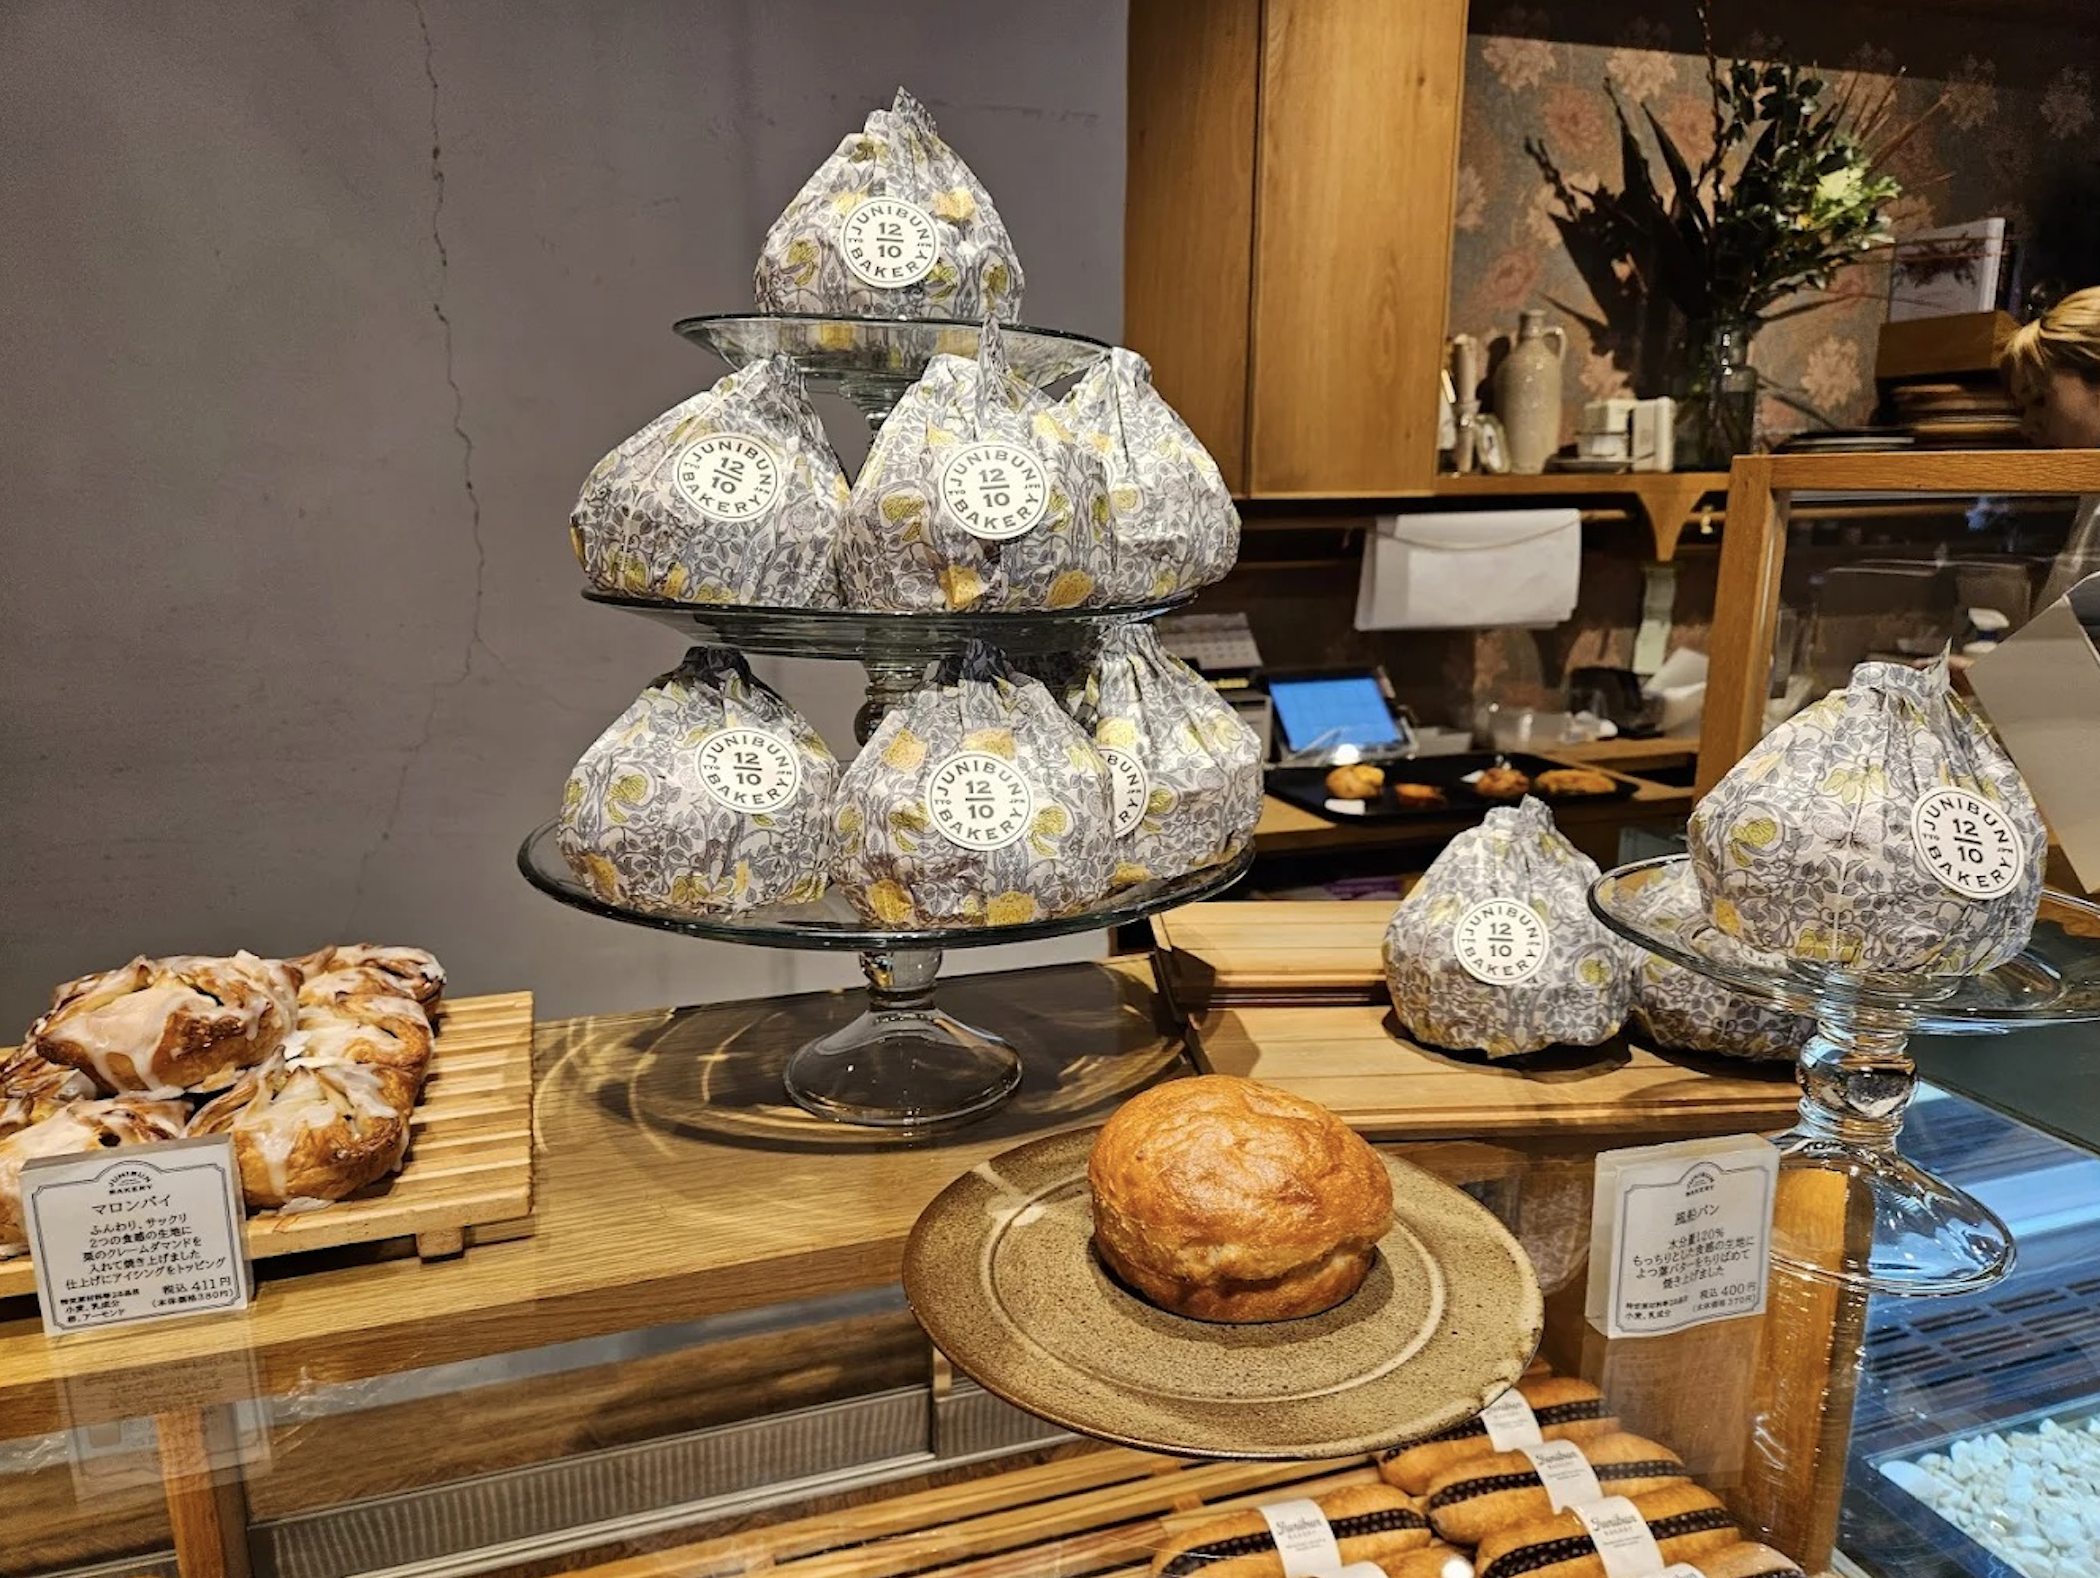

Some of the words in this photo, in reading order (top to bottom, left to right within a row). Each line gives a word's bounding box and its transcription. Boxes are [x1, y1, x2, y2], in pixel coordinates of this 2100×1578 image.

[852, 205, 930, 240] JUNIBUN
[878, 222, 902, 236] 12
[878, 245, 902, 258] 10
[851, 247, 928, 278] BAKERY
[692, 441, 772, 485] JUNIBUN
[721, 457, 745, 475] 12
[950, 450, 1037, 486] JUNIBUN
[712, 477, 736, 494] 10
[978, 469, 1006, 483] 12
[683, 472, 761, 513] BAKERY
[982, 492, 1010, 507] 10
[953, 493, 1039, 529] BAKERY
[706, 735, 789, 767] JUNIBUN
[735, 752, 760, 765] 12
[736, 773, 762, 785] 10
[937, 760, 1022, 796] JUNIBUN
[966, 781, 992, 794] 12
[707, 774, 789, 805] BAKERY
[968, 805, 994, 819] 10
[1924, 798, 2009, 843] JUNIBUN
[939, 807, 1023, 840] BAKERY
[1953, 819, 1979, 836] 12
[1958, 846, 1983, 864] 10
[1928, 846, 2011, 887] BAKERY
[1465, 906, 1539, 938] JUNIBUN
[1490, 923, 1512, 935] 12
[1490, 944, 1512, 957] 10
[1464, 947, 1537, 976] BAKERY
[92, 1195, 171, 1215] マロンパイ
